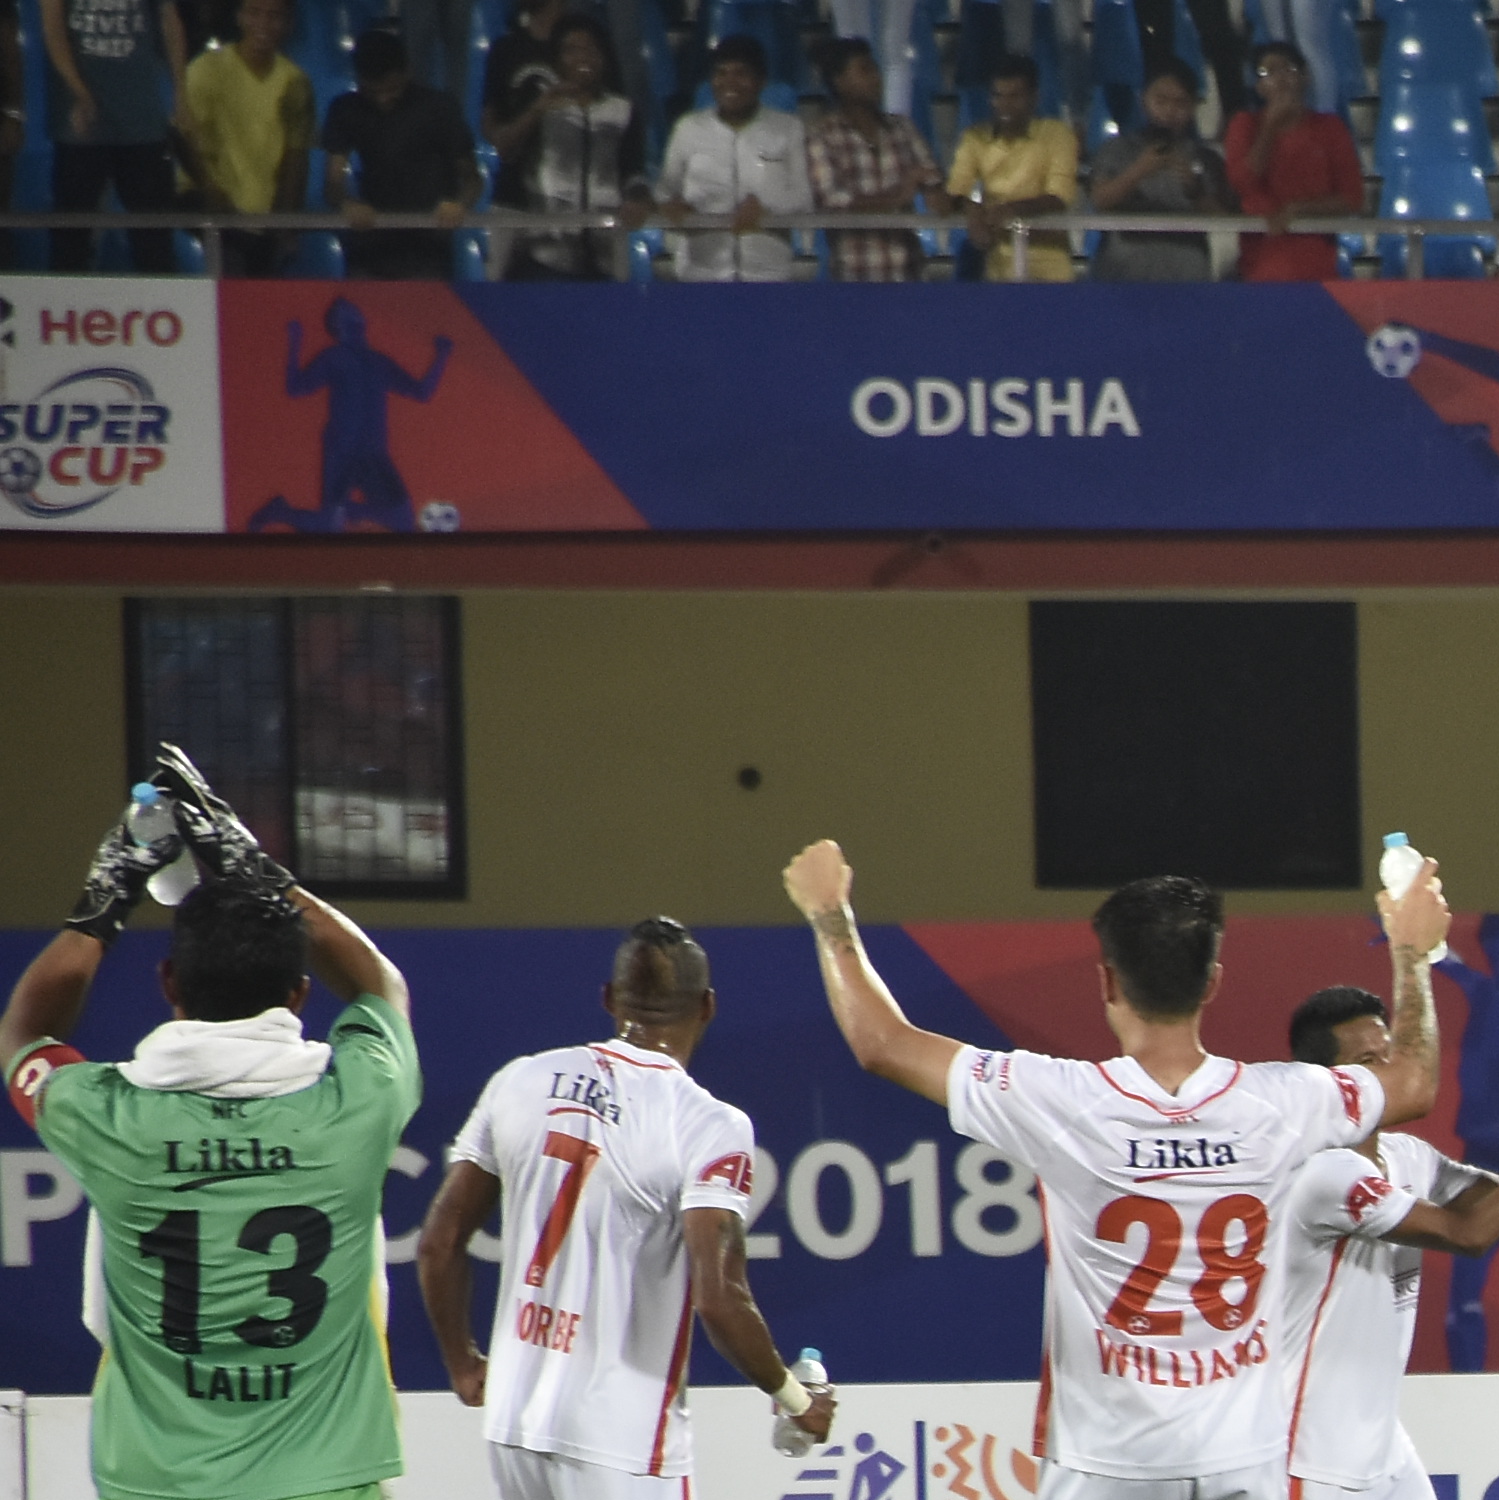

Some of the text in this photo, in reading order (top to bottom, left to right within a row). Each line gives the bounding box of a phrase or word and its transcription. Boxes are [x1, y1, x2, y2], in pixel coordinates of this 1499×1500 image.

[0, 404, 171, 444] SUPER
[850, 376, 1141, 438] ODISHA
[48, 446, 166, 486] CUP
[547, 1072, 622, 1126] Lika
[163, 1138, 297, 1174] Likla
[1125, 1137, 1238, 1169] Likla
[525, 1130, 602, 1288] 7
[139, 1205, 332, 1355] 13
[1095, 1193, 1269, 1336] 28
[184, 1358, 297, 1402] LALIT
